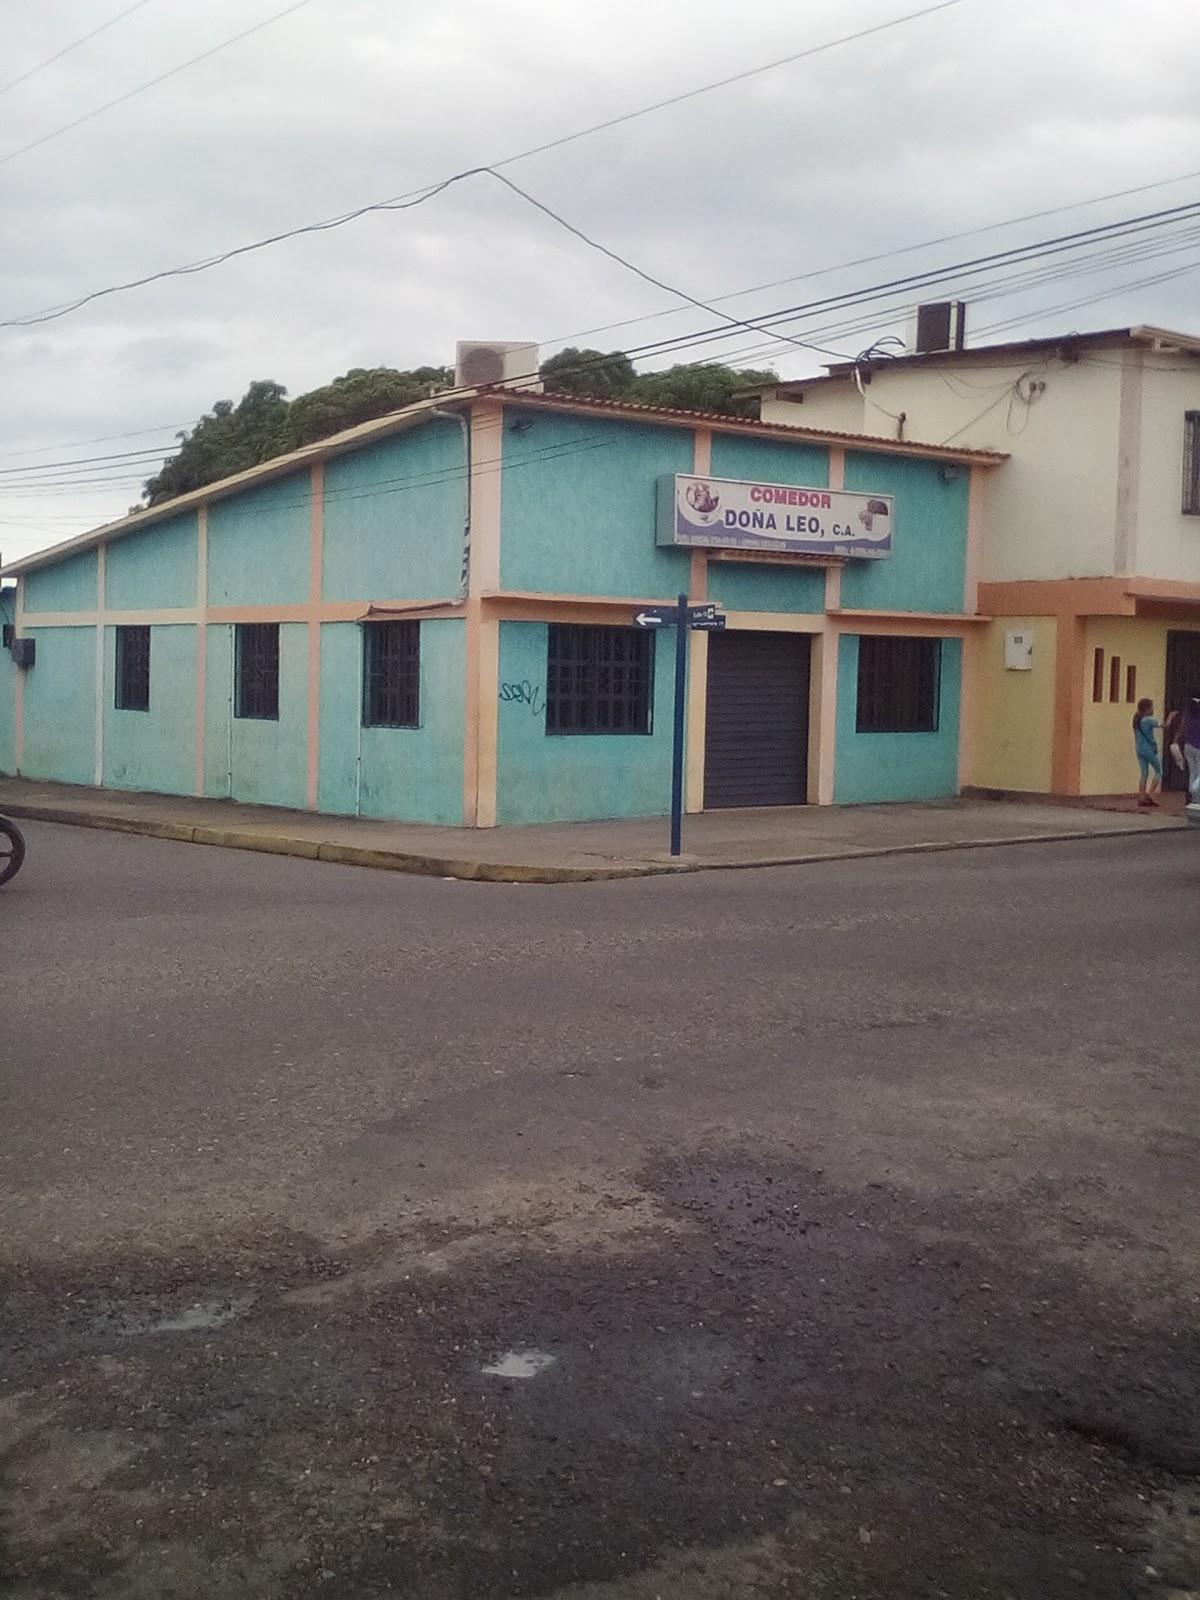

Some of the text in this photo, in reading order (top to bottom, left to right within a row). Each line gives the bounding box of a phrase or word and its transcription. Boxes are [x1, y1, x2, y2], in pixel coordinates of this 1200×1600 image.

[750, 487, 831, 509] COMEDOR
[724, 508, 856, 537] DOÑA LEO, C.A.
